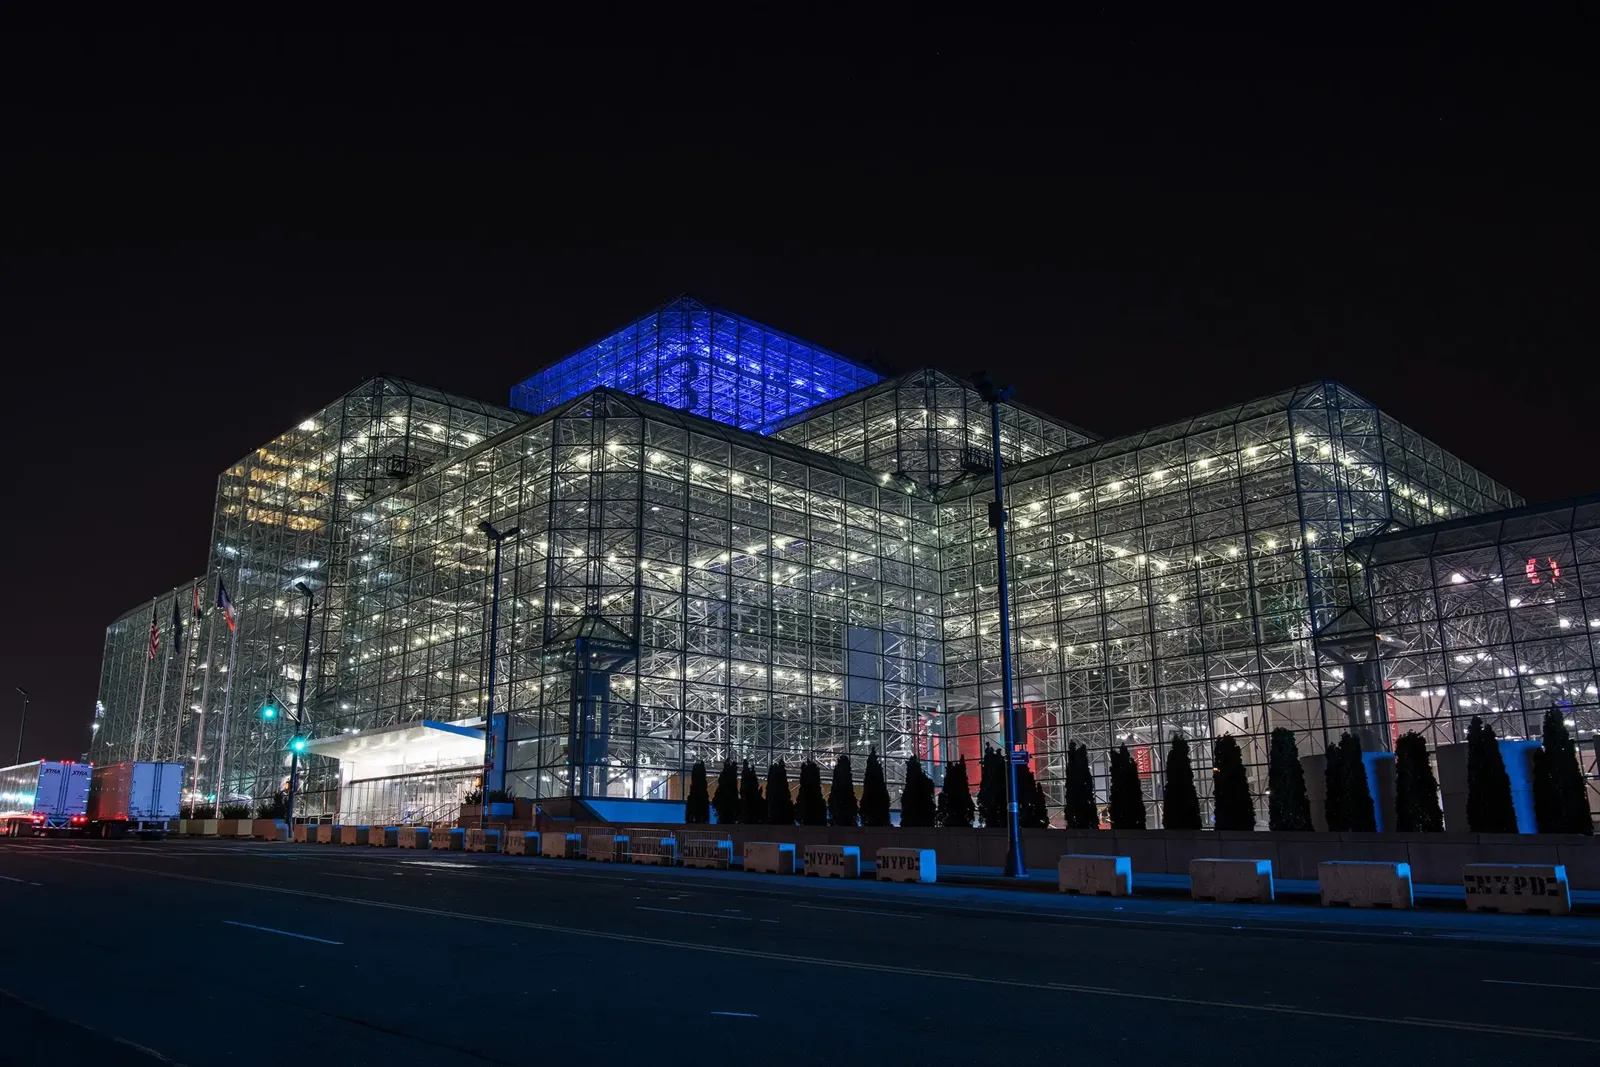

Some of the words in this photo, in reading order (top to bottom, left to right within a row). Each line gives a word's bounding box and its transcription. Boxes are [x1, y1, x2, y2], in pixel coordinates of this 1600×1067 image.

[809, 850, 840, 866] NYPD
[881, 856, 915, 870] NYPD
[1476, 875, 1546, 896] NYPD
